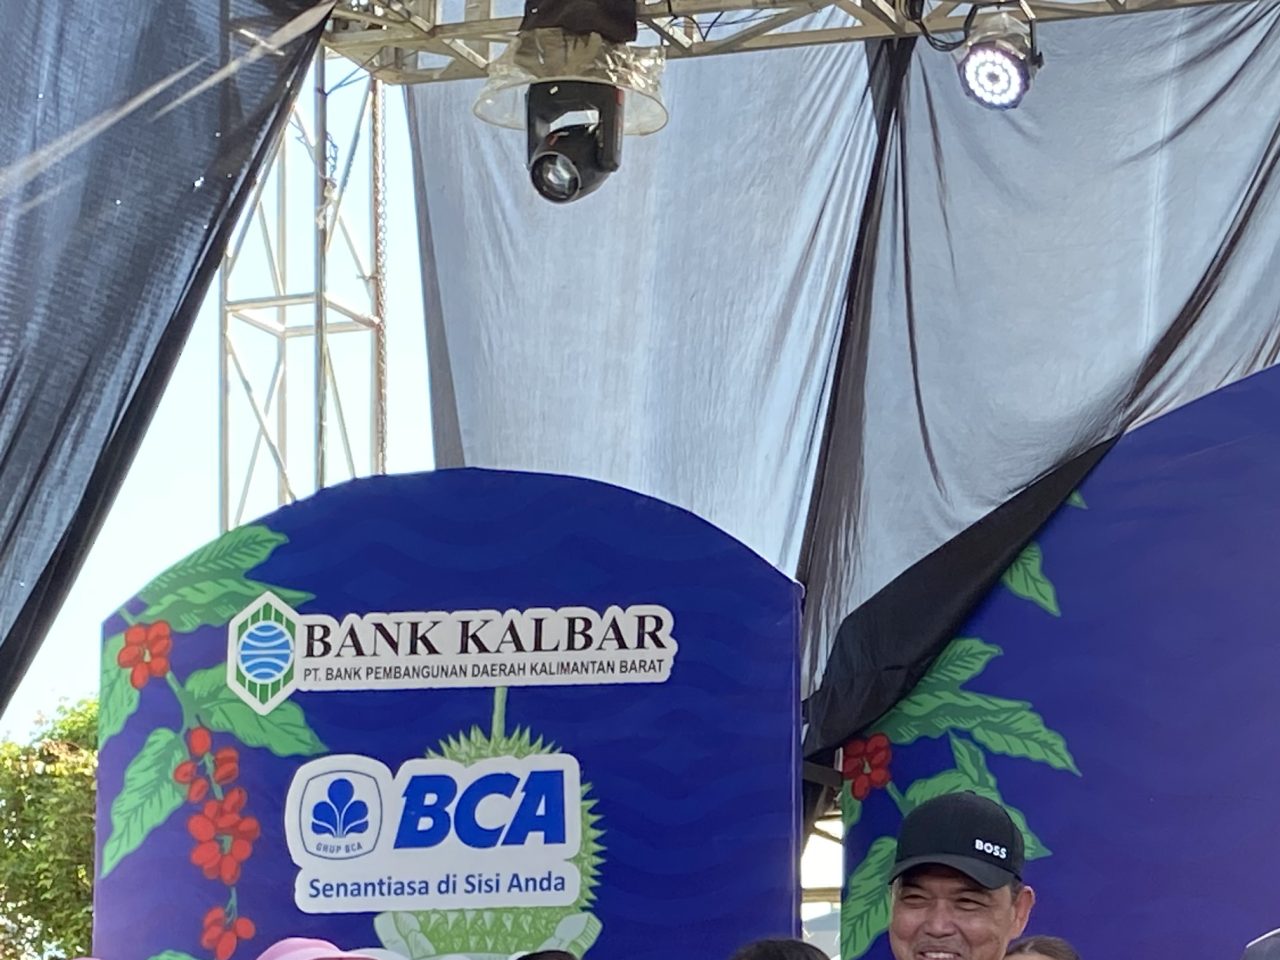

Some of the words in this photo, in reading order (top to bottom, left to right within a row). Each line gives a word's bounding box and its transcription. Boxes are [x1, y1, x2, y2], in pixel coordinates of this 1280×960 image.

[302, 620, 443, 658] BANK
[456, 614, 668, 654] KALBAR
[303, 667, 322, 682] PT.
[325, 667, 362, 681] BANK
[366, 664, 468, 680] PEMBANGUNAN
[471, 662, 526, 678] DAERAH
[530, 660, 616, 676] KALIMANTAN
[619, 659, 664, 674] BARAT
[393, 770, 567, 849] BCA
[345, 841, 363, 853] BCA
[974, 838, 1008, 860] BOSS
[308, 876, 429, 898] Senantiasa
[437, 874, 457, 894] di
[464, 873, 500, 894] Sisi
[507, 870, 566, 893] Anda
